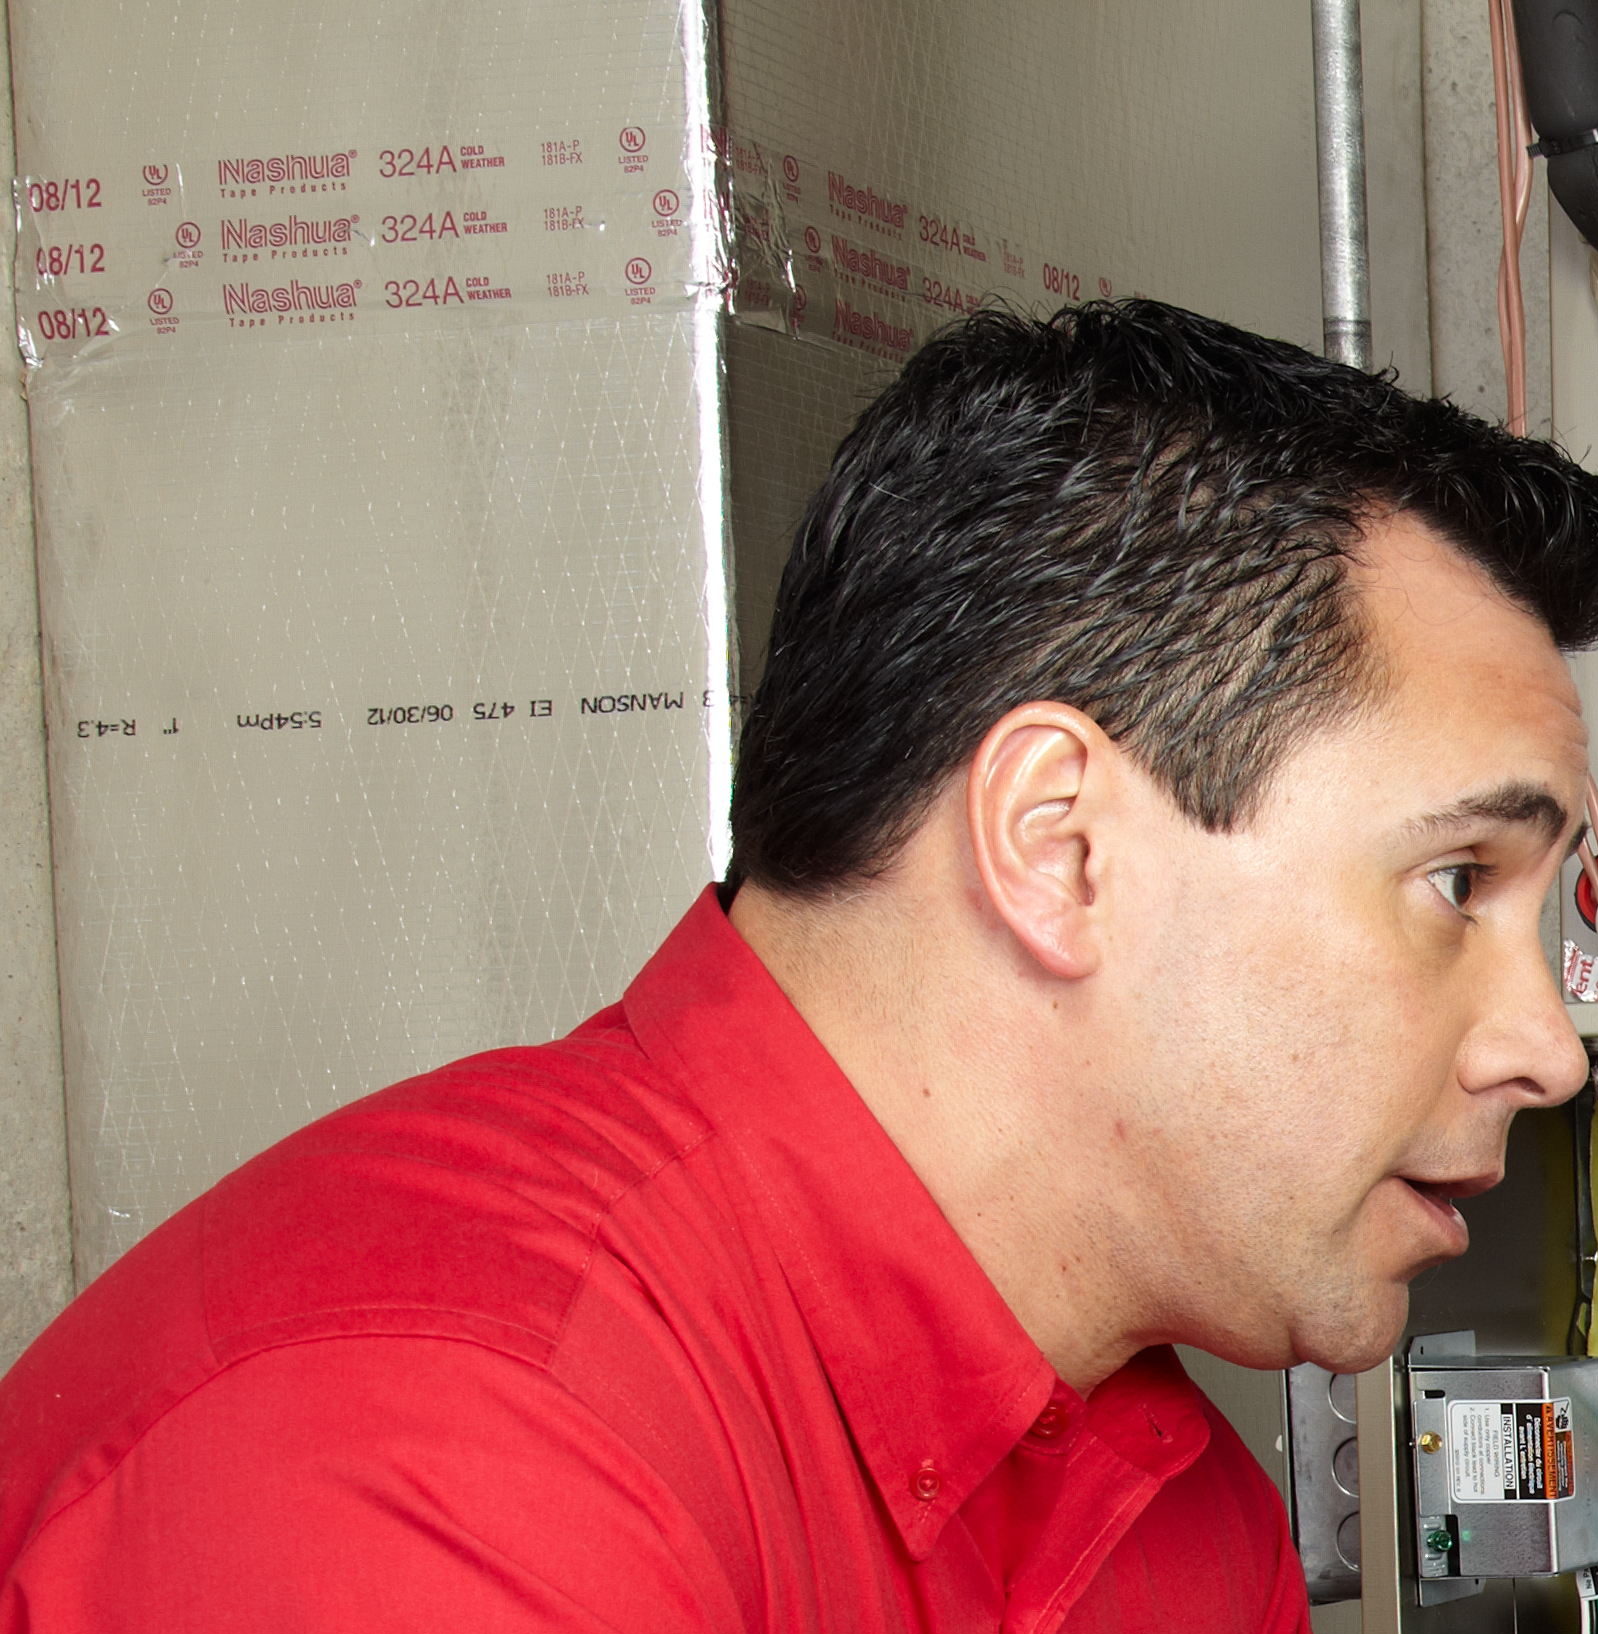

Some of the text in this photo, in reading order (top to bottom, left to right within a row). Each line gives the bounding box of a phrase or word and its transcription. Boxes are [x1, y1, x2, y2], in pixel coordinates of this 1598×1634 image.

[460, 145, 485, 157] COLD
[541, 140, 580, 154] 181A-P
[379, 145, 457, 178] 324A
[460, 156, 505, 170] WEATHER
[541, 152, 583, 166] 181B-FX
[618, 156, 649, 165] LISTED
[28, 178, 103, 213] 08/12
[142, 188, 171, 198] LISTED
[220, 181, 347, 199] Tape Products
[463, 211, 487, 222] COLD
[543, 206, 583, 219] 181A-P
[381, 210, 459, 244] 324A
[463, 222, 508, 235] WEATHER
[651, 219, 683, 228] LISTED
[919, 215, 961, 255] 324A
[36, 243, 106, 276] 08/12
[222, 246, 348, 264] Tape Products
[466, 277, 490, 288] COLD
[546, 271, 585, 285] 181A-P
[1043, 263, 1081, 302] 08/12
[384, 276, 465, 309] 324A
[467, 288, 512, 301] WEATHER
[547, 283, 589, 298] 181B-FX
[625, 287, 656, 297] LISTED
[922, 277, 967, 316] 324A
[37, 307, 111, 340] 08/12
[150, 316, 180, 327] LISTED
[229, 310, 355, 328] Tape Products
[530, 700, 553, 717] EI
[581, 691, 685, 714] MANSON
[367, 704, 453, 726] 06/30/12
[473, 702, 515, 721] 475
[77, 718, 137, 738] R=4.3
[1503, 1416, 1514, 1488] INSTALLATION
